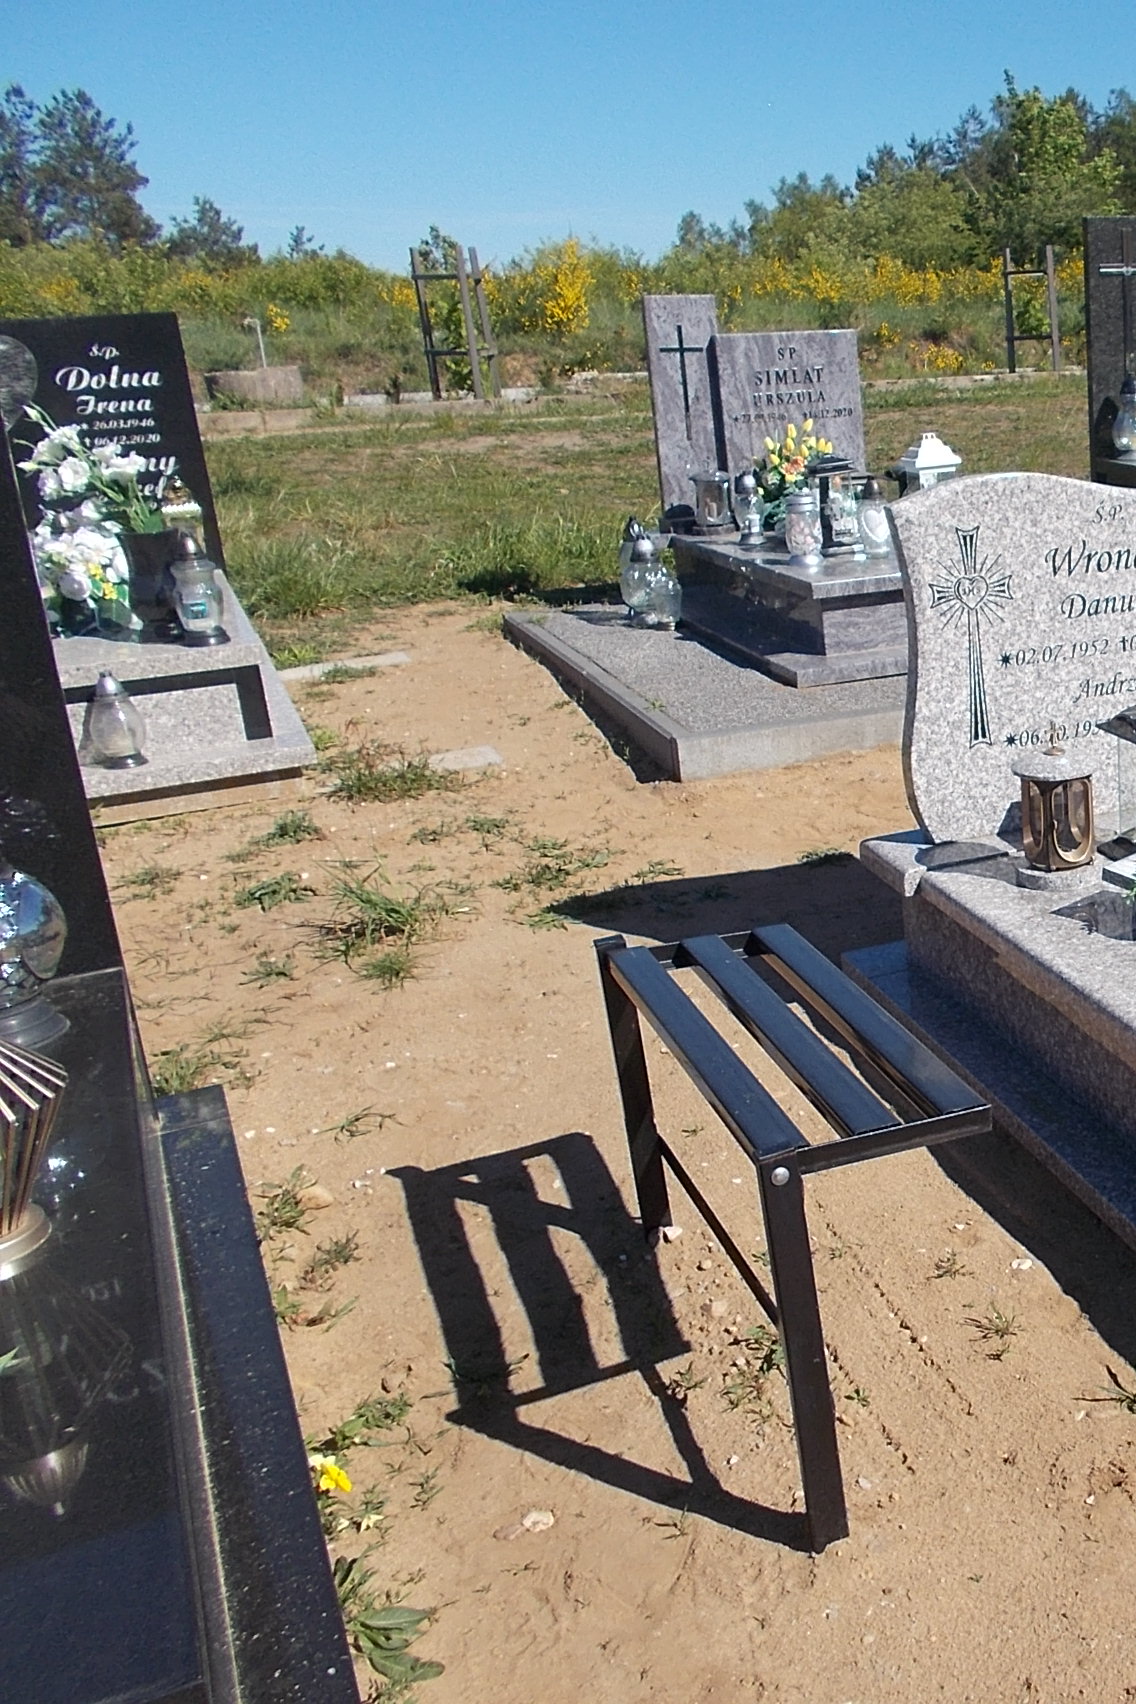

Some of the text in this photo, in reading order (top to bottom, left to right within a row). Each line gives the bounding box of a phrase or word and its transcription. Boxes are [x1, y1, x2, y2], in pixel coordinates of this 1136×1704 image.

[55, 365, 162, 391] Dolna
[754, 365, 824, 387] SIMLAT
[76, 394, 154, 415] Irena
[752, 389, 826, 407] URSZULA
[1015, 638, 1110, 667] 02.07.1952
